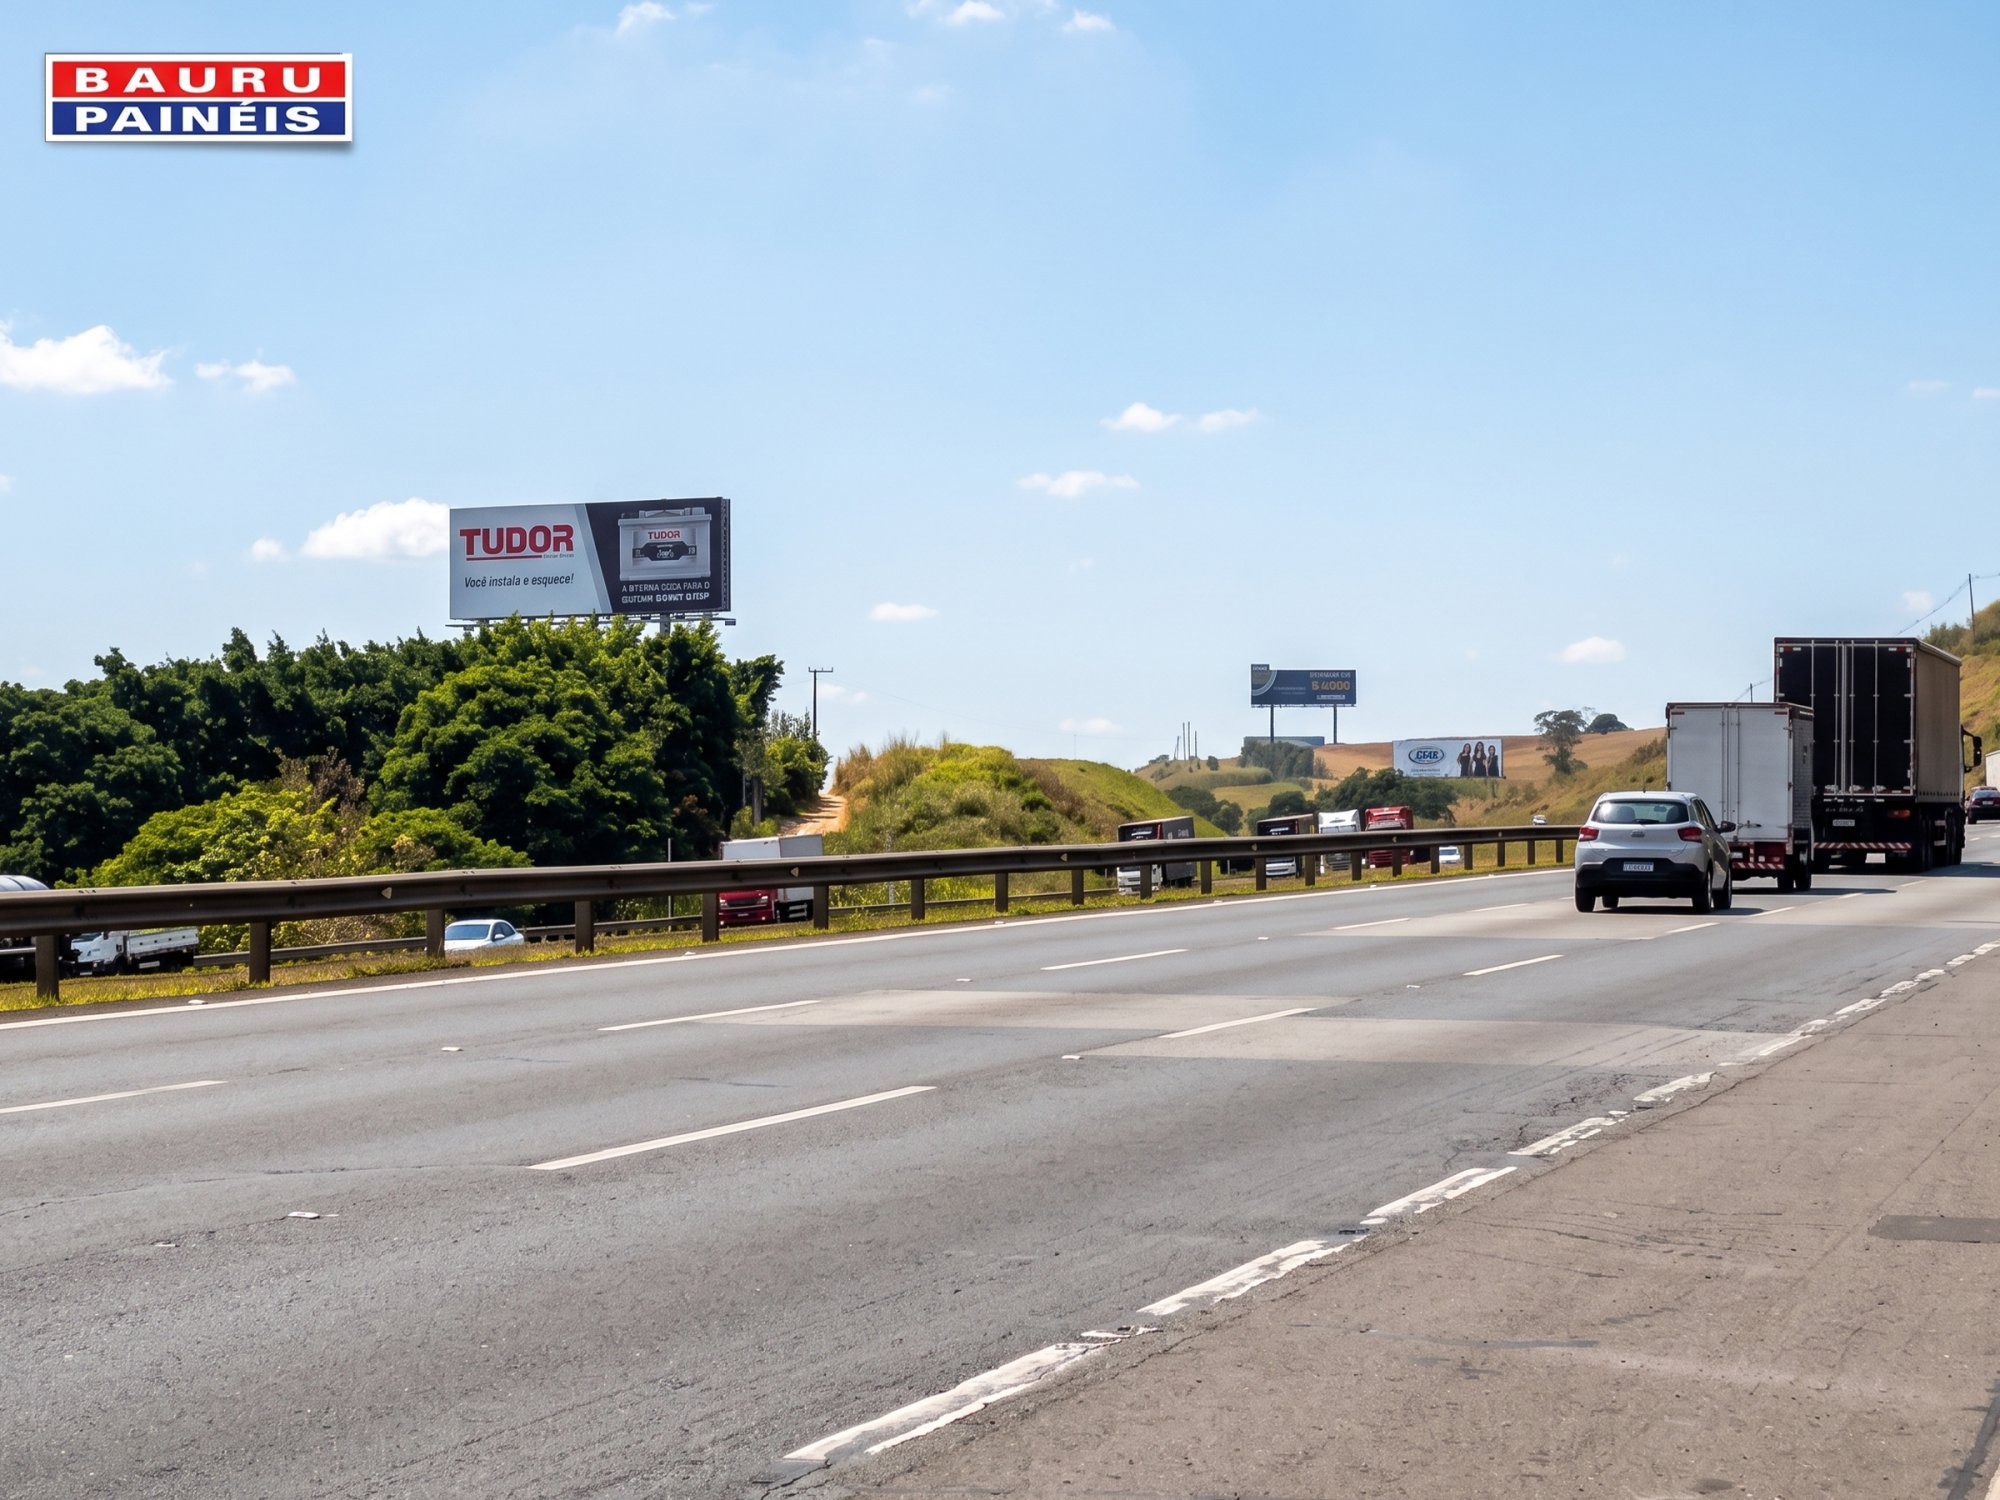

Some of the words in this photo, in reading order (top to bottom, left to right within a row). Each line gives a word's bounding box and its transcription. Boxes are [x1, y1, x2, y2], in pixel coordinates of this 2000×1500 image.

[459, 524, 574, 556] TUDOR
[647, 530, 681, 540] TUDOR
[464, 576, 487, 588] Você
[488, 575, 520, 587] instala
[523, 577, 529, 586] e
[531, 573, 574, 588] esquece!
